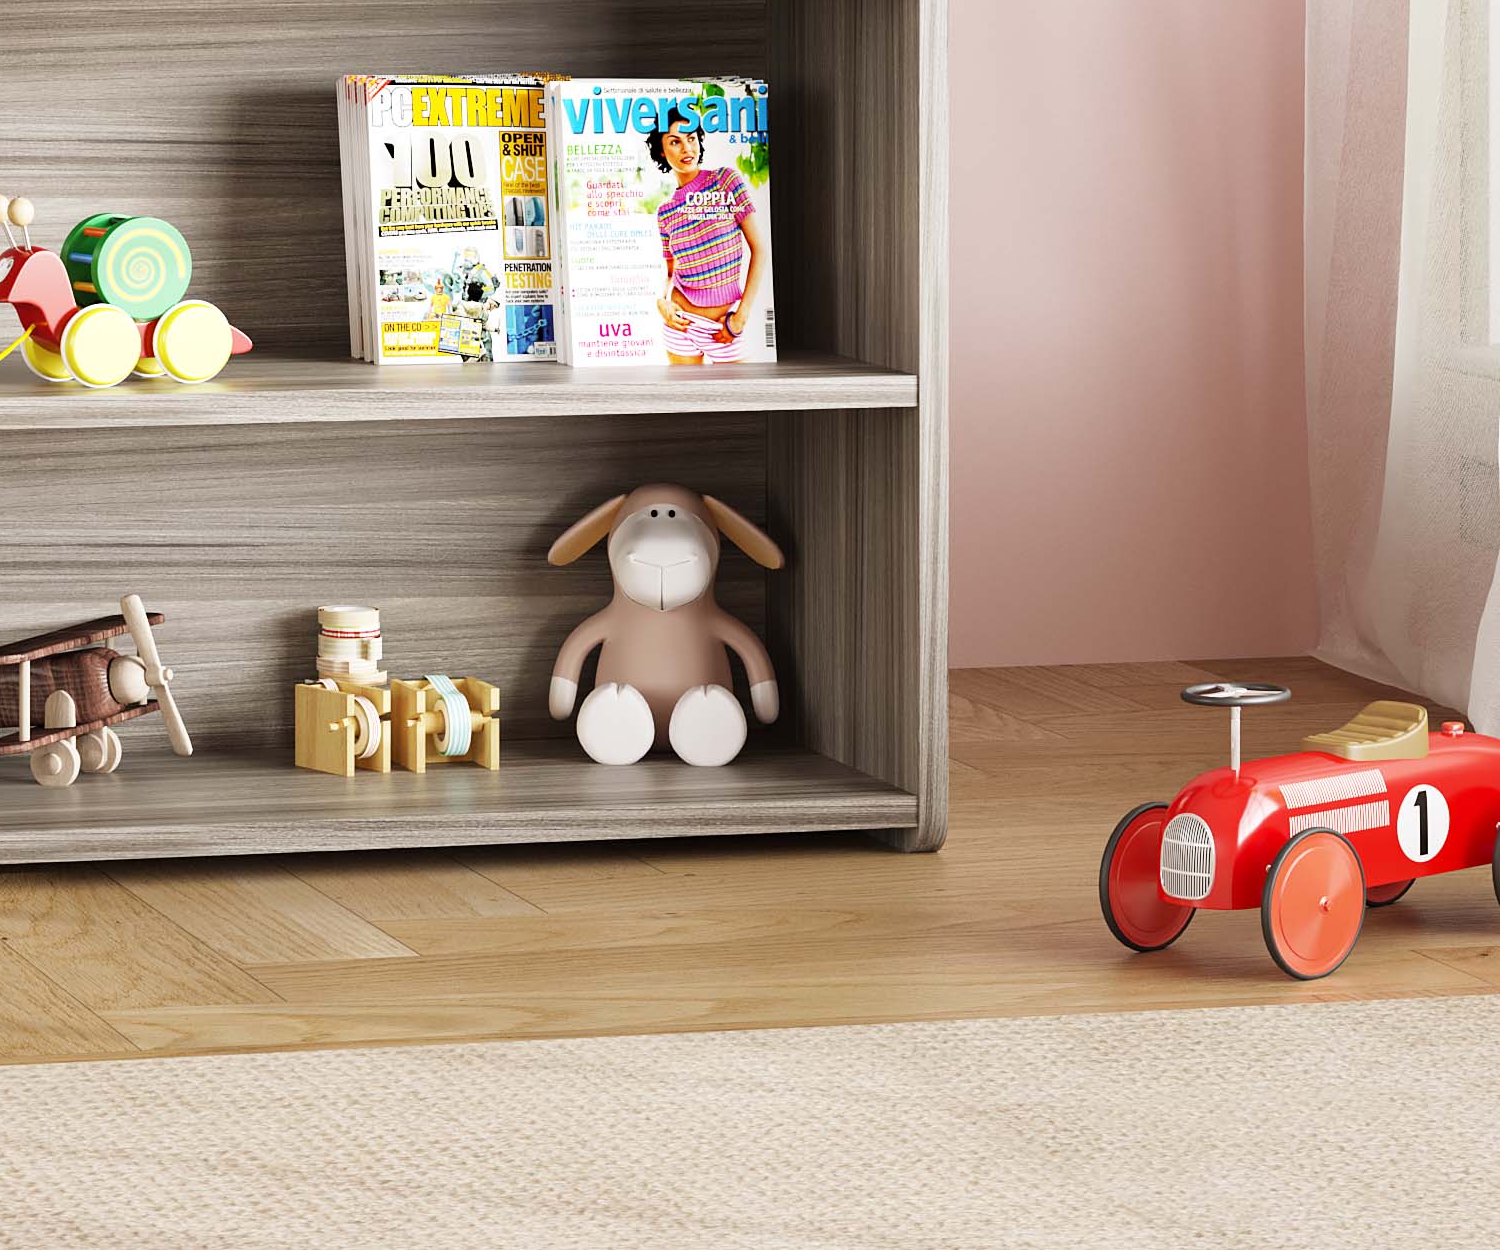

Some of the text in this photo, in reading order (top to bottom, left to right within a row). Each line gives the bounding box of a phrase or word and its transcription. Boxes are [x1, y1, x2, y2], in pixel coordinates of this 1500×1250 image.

[562, 85, 769, 135] viversani
[501, 133, 544, 144] OPEN
[729, 135, 737, 143] &
[502, 144, 544, 157] & SHUT
[566, 144, 622, 155] BELLEZZA
[381, 130, 486, 188] 100
[502, 156, 545, 181] CASE
[380, 188, 491, 207] PERFORMANCE
[686, 191, 736, 206] COPPIA
[379, 205, 466, 224] COMPUTING
[504, 263, 552, 272] PENETRATION
[505, 272, 553, 289] TESTING
[384, 323, 422, 332] ON THE CD
[599, 323, 632, 337] uva
[1413, 790, 1428, 856] 1
